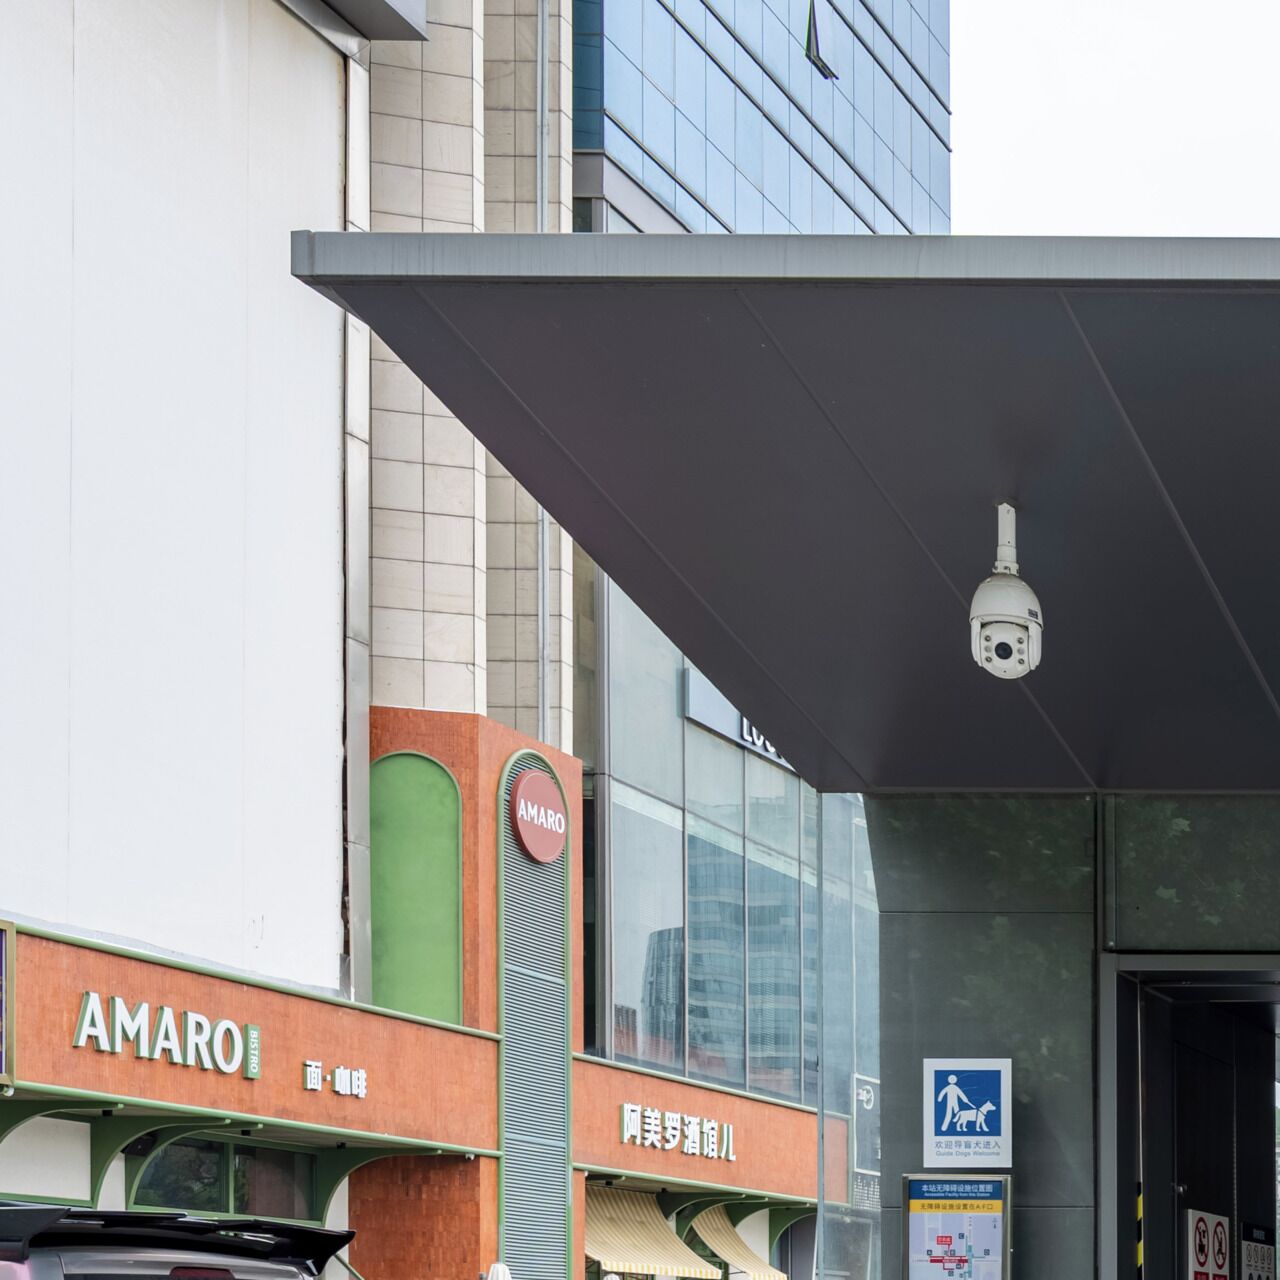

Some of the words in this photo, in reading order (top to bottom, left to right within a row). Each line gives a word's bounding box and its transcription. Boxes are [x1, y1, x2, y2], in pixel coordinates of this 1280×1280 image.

[516, 798, 567, 835] AMARO
[72, 990, 243, 1074] AMARO
[249, 1029, 258, 1073] BISTRO
[621, 1102, 737, 1162] 阿美罗酒馆儿
[934, 1140, 1001, 1150] 欢迎导盲犬进入
